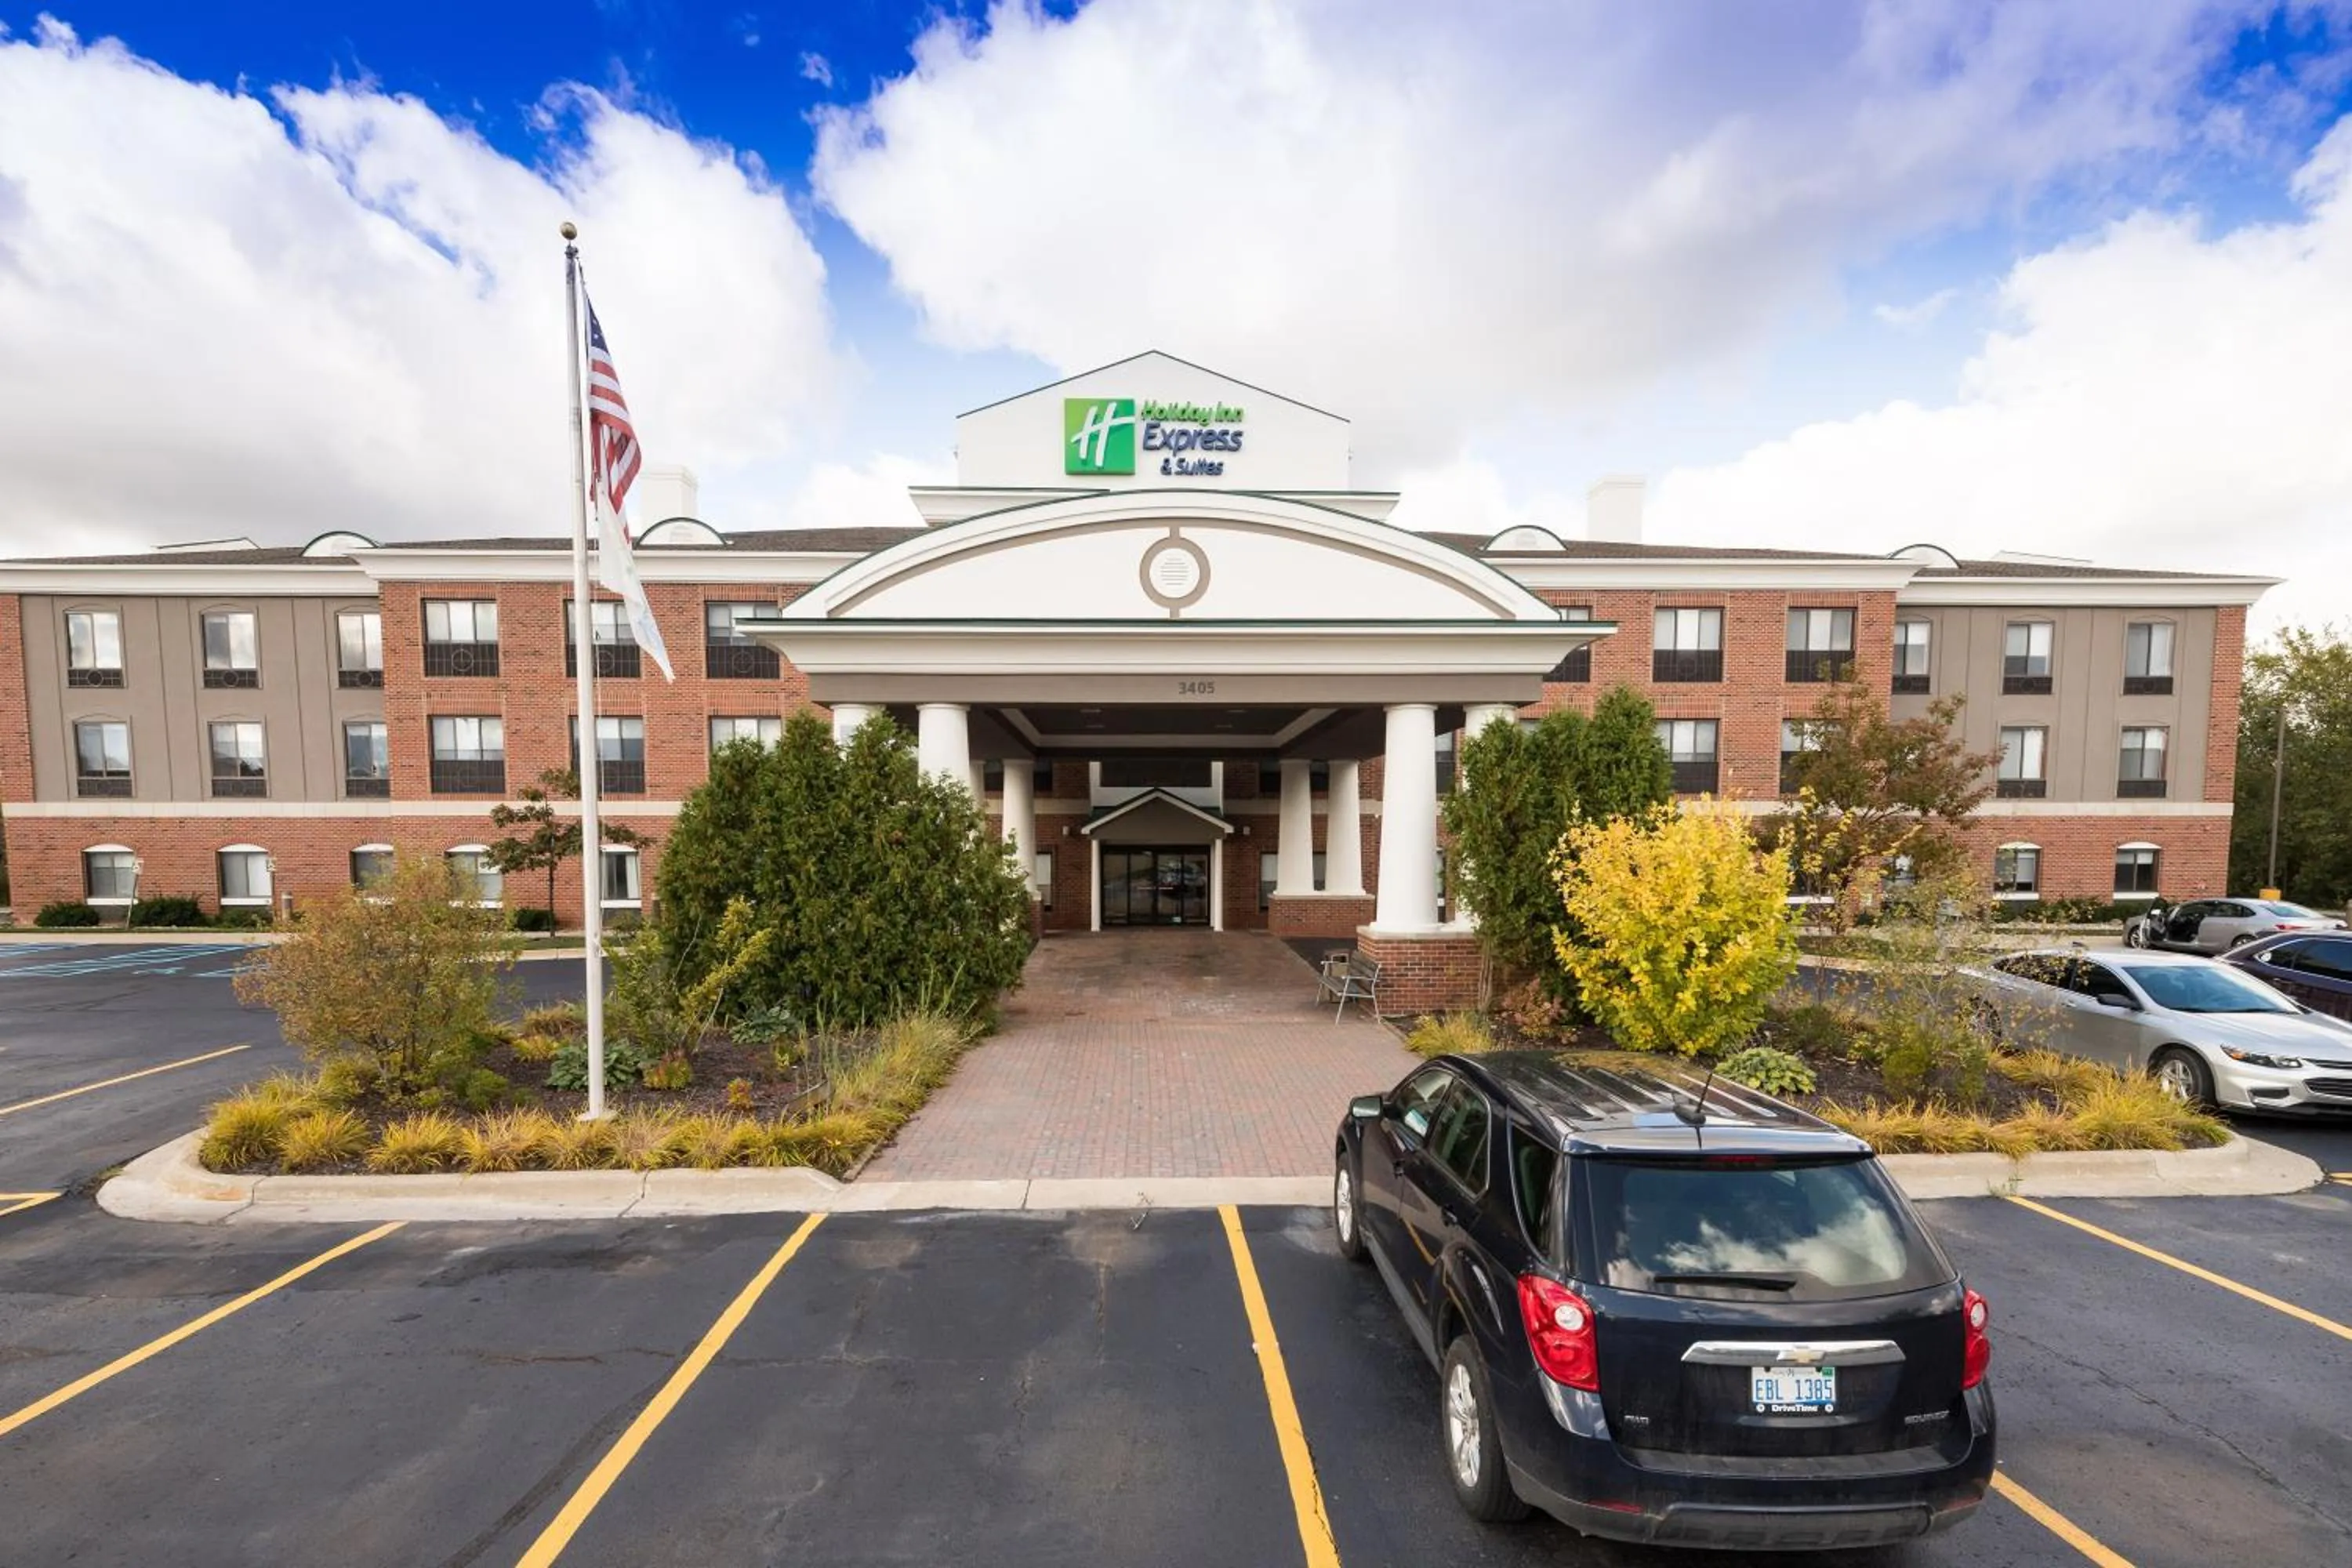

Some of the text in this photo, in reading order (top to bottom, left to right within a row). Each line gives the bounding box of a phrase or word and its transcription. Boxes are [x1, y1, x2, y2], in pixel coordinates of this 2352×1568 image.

[1142, 401, 1243, 426] Holiday Inn
[1142, 422, 1243, 456] Express
[1160, 457, 1224, 476] & Suites
[1178, 681, 1214, 695] 3405
[1755, 1379, 1832, 1401] EBL 1385
[1771, 1403, 1819, 1412] DriveTime
